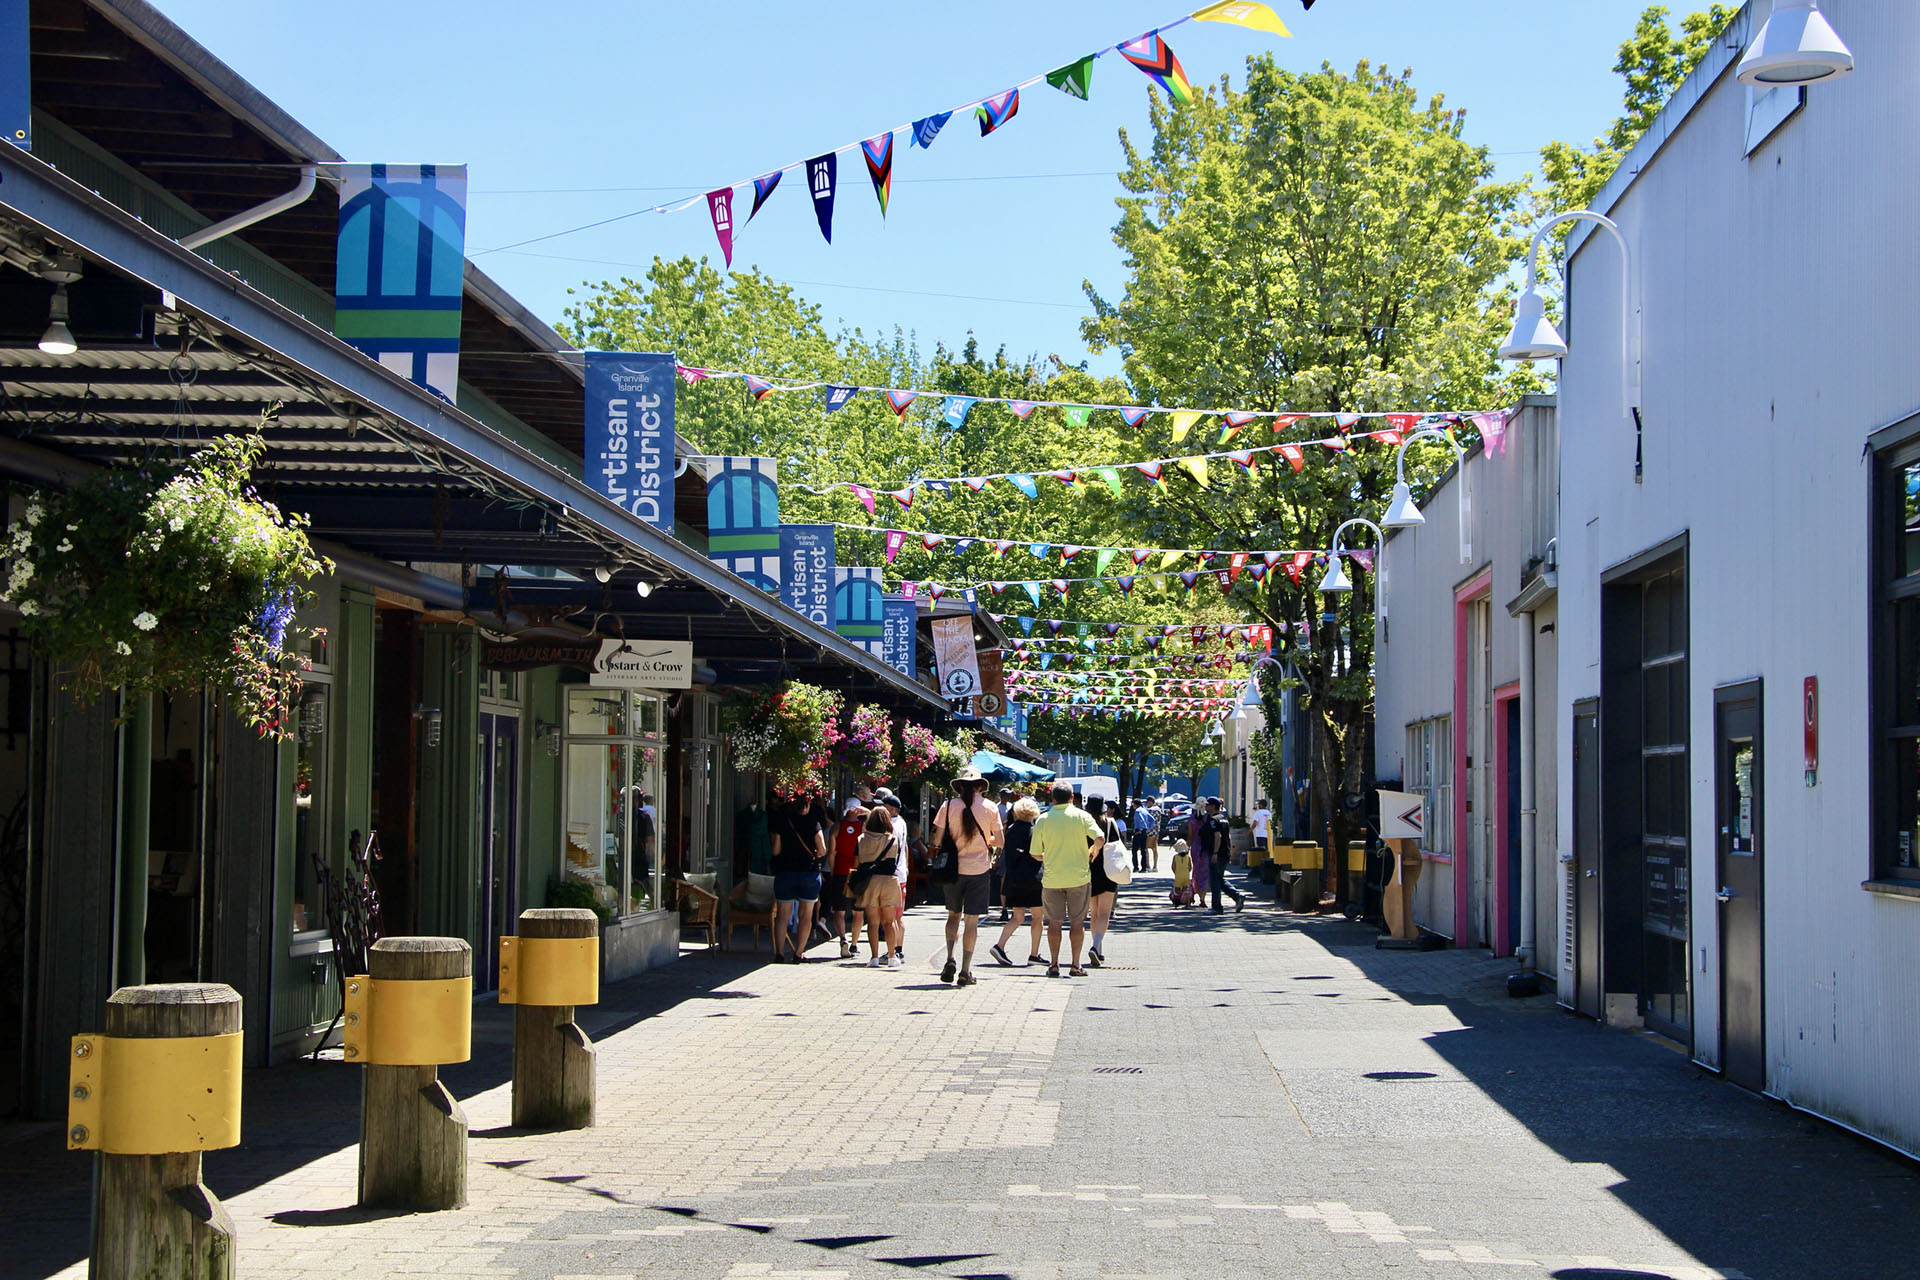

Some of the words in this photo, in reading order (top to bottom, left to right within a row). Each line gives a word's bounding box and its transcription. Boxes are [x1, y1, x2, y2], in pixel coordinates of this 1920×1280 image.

[610, 373, 650, 383] Granville
[618, 383, 643, 392] Island
[632, 393, 661, 523] District
[809, 546, 827, 625] District
[883, 619, 894, 667] rtisan
[599, 660, 640, 672] Upstart
[642, 661, 651, 672] &
[653, 662, 683, 672] Crow
